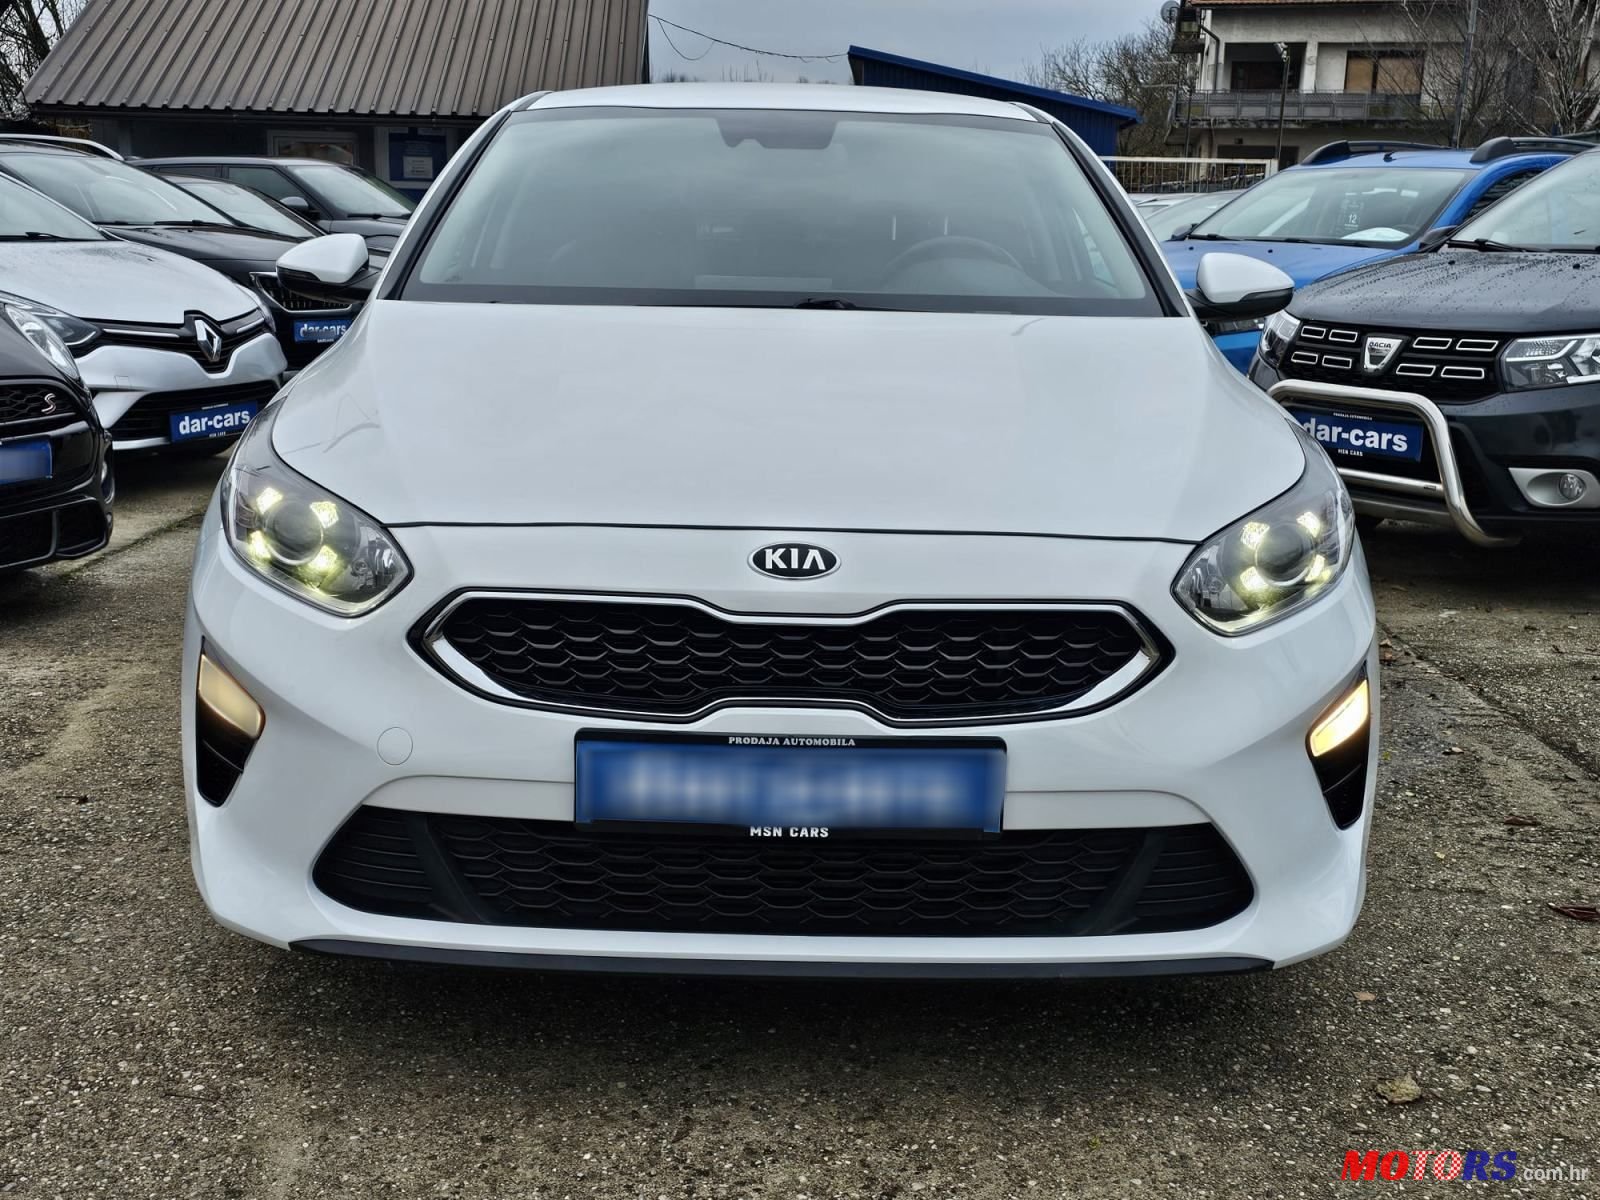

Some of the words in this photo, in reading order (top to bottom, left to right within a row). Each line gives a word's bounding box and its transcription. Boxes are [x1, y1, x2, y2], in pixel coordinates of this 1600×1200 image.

[41, 392, 57, 415] S
[179, 410, 251, 435] dar-cars
[1303, 418, 1409, 452] dar-cars
[764, 547, 827, 570] KIA
[728, 736, 780, 745] PRODAJA
[782, 738, 856, 747] AUTOMOBILA
[750, 826, 783, 837] MSN
[789, 827, 829, 838] CARS
